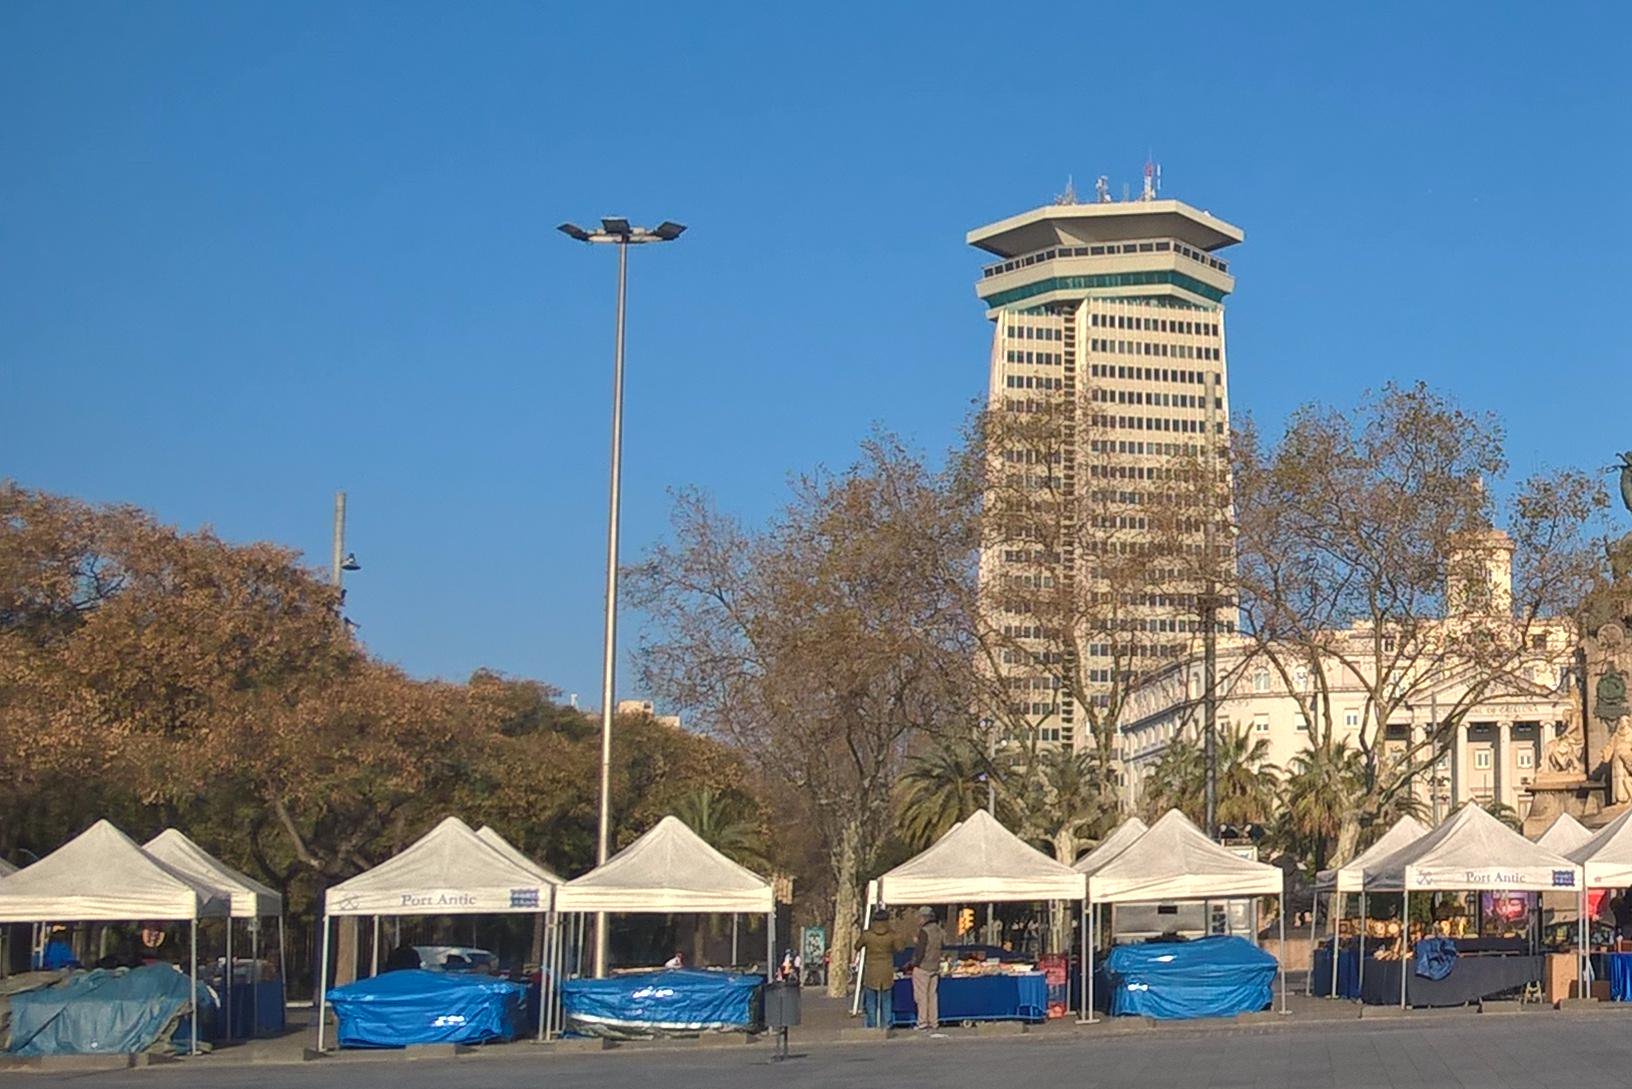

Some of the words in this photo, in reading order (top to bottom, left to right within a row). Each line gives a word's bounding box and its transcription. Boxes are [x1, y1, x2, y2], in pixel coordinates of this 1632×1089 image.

[1465, 871, 1491, 884] Port
[1494, 871, 1526, 884] Antic
[401, 894, 432, 907] Port
[437, 893, 477, 906] Antic
